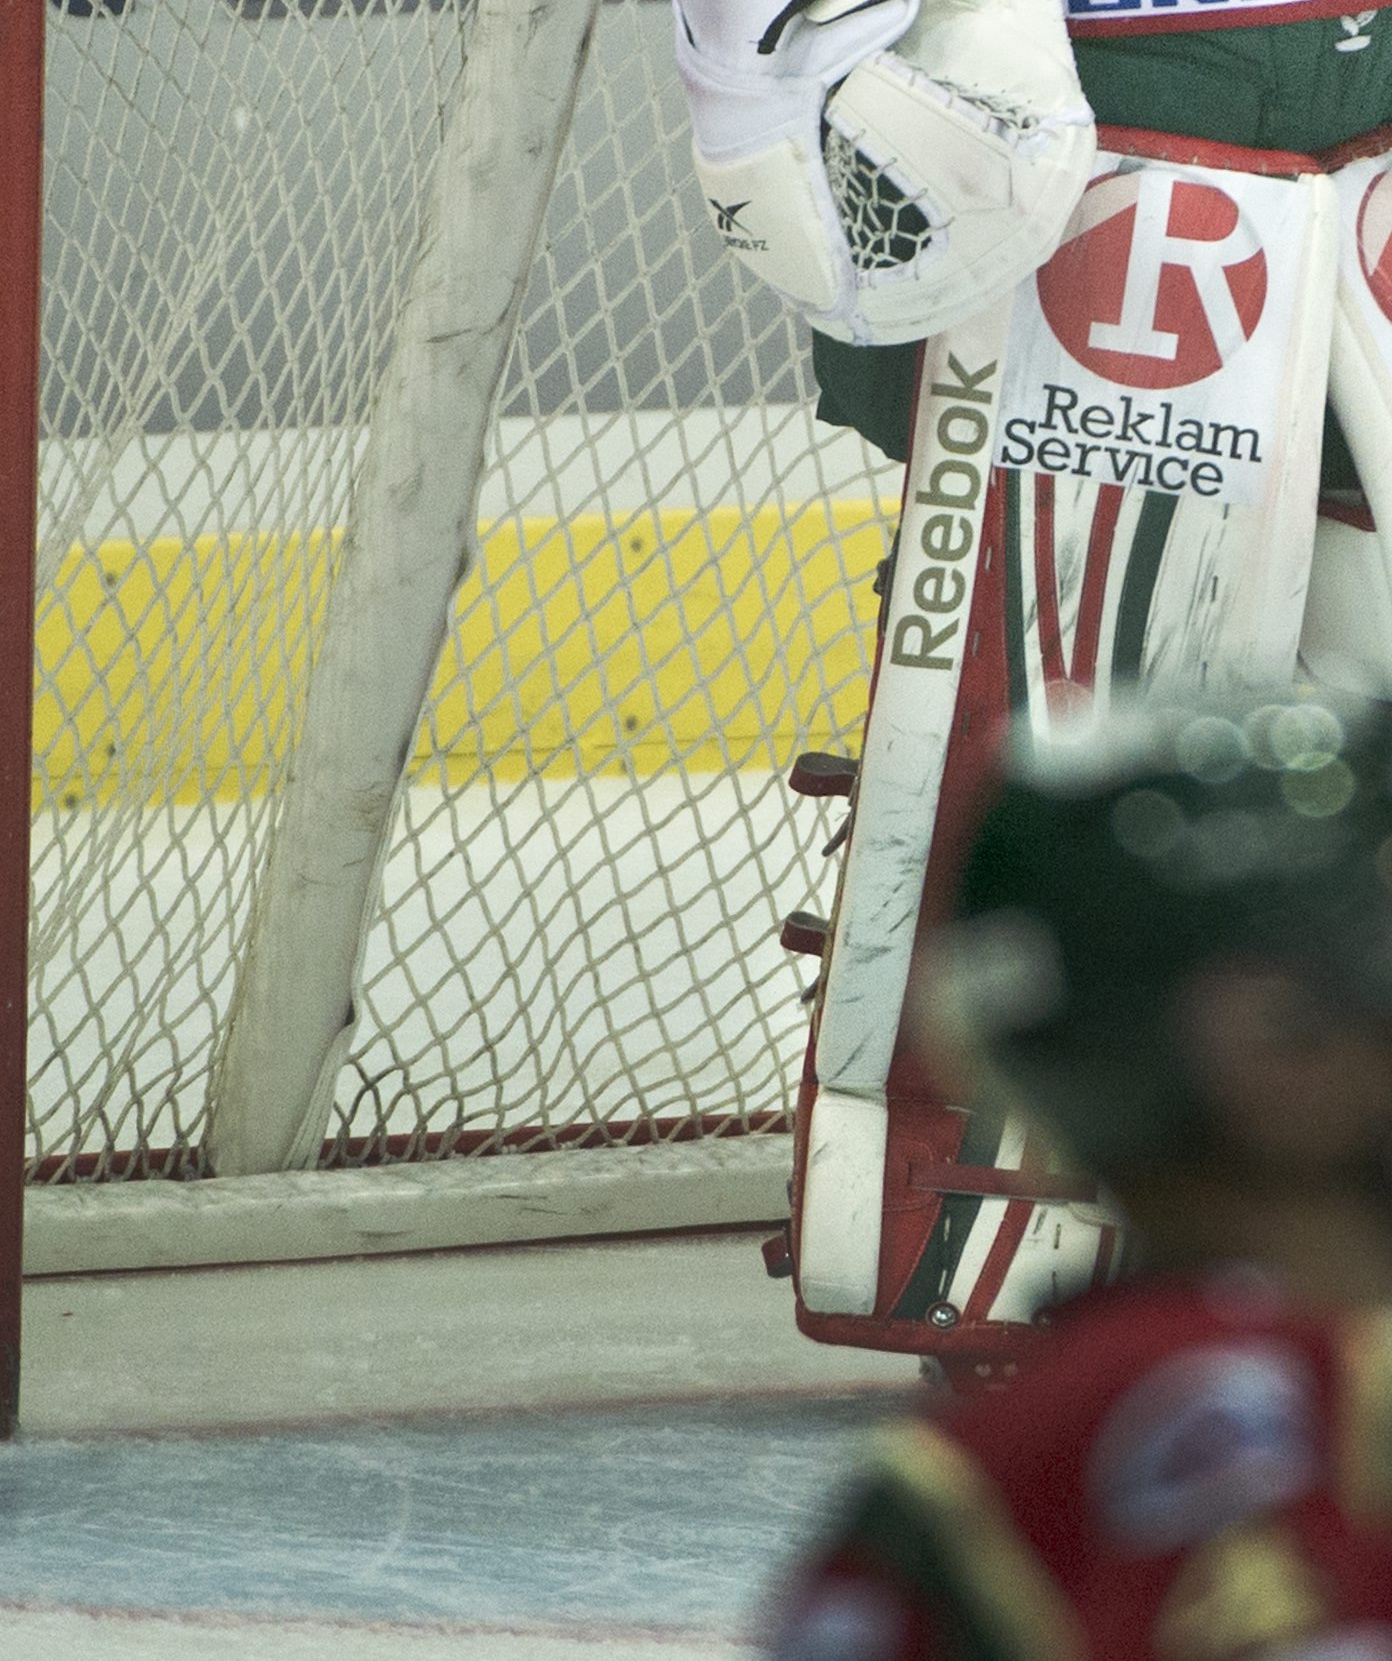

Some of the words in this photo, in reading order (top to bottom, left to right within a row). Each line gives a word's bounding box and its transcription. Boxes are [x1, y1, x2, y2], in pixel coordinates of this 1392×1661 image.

[1000, 417, 1225, 498] Service
[1037, 383, 1263, 463] Reklam
[889, 349, 999, 671] Reebok
